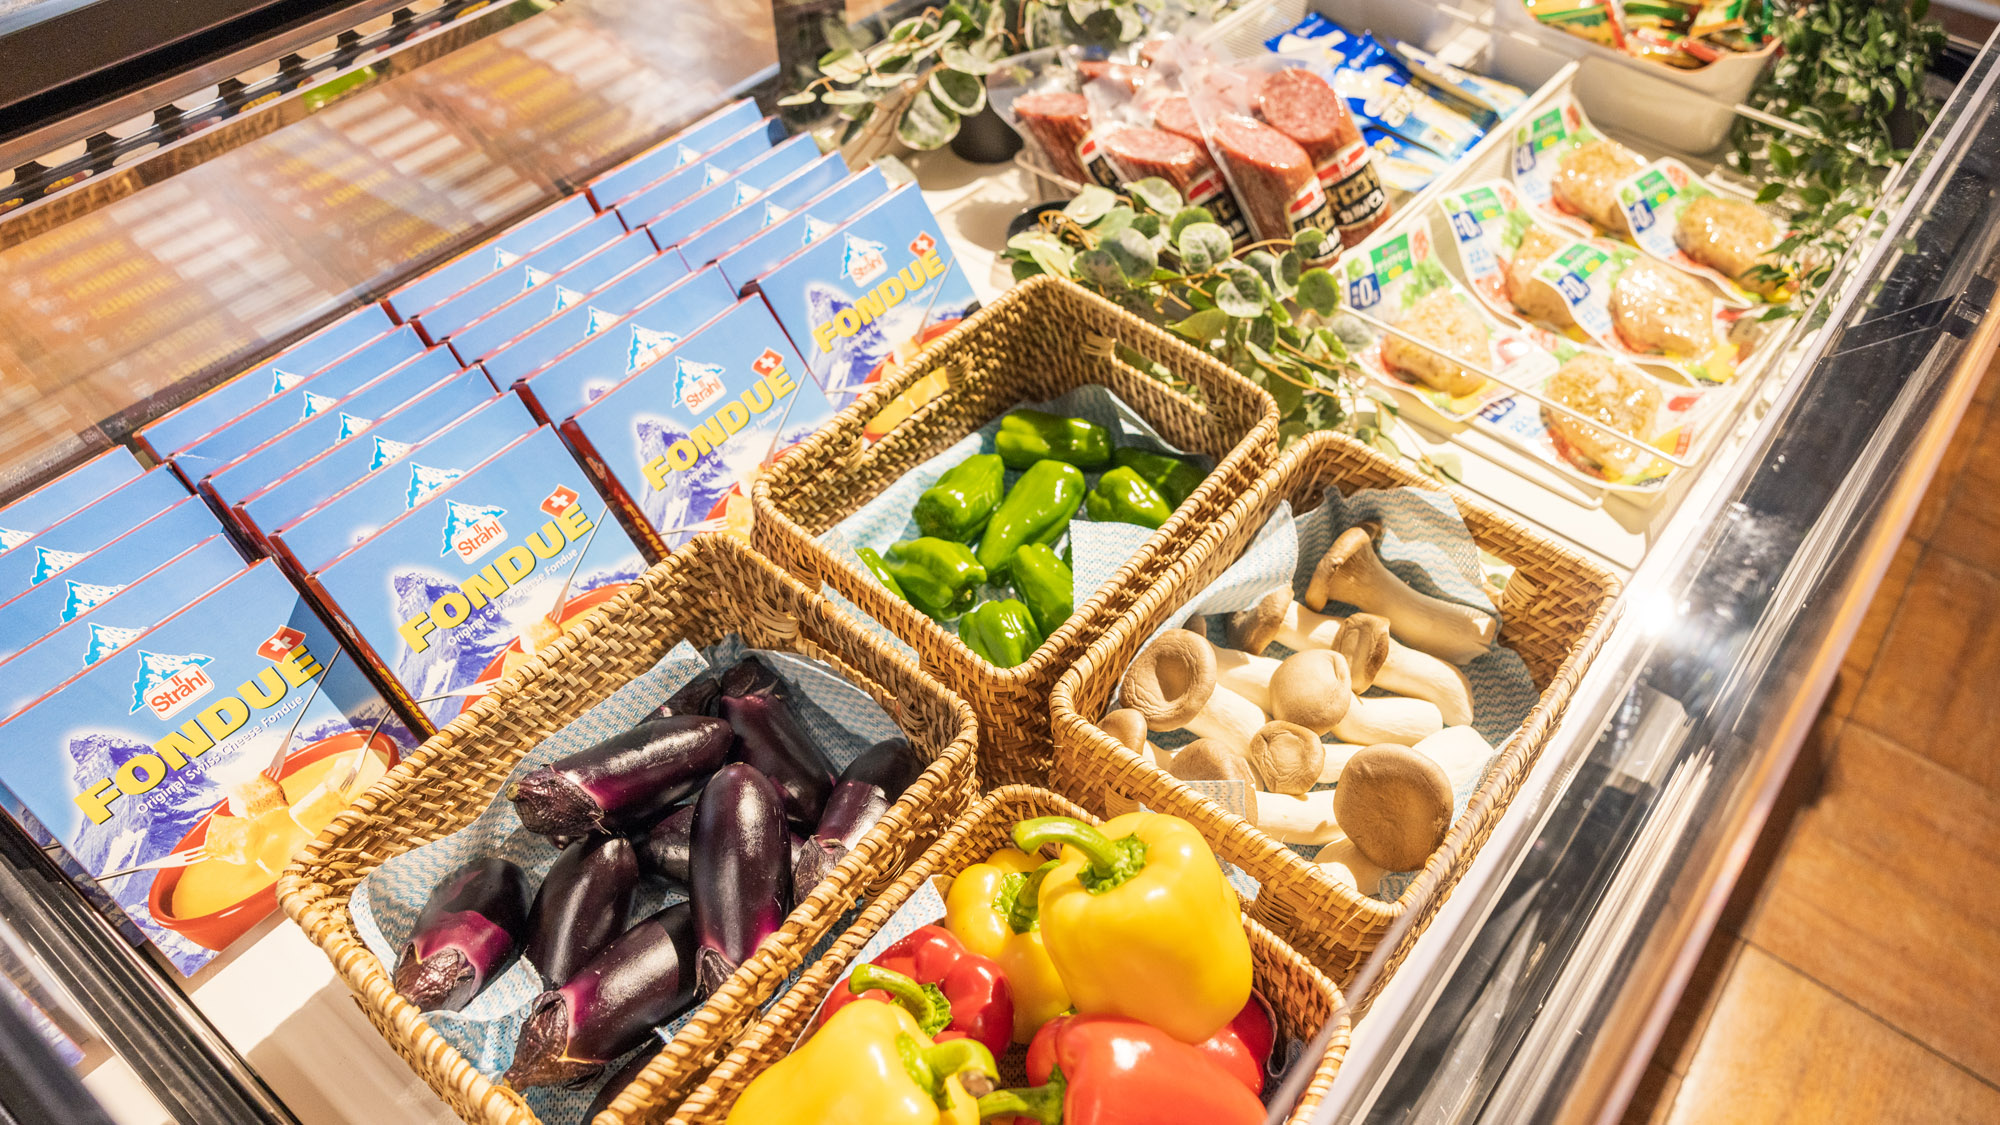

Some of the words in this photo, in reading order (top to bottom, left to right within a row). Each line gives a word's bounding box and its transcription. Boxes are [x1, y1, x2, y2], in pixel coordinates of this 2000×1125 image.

[812, 249, 946, 353] FONDUE
[641, 365, 797, 491] FONDUE
[398, 503, 595, 653] FONDUE
[457, 521, 503, 556] Strähl
[447, 616, 487, 646] Original
[544, 549, 579, 576] Fondue
[73, 645, 325, 825] FONDUE
[151, 671, 207, 713] Strähl
[136, 778, 187, 815] Original
[187, 753, 222, 781] Swiss
[221, 724, 264, 756] Cheese
[260, 695, 304, 729] Fondue
